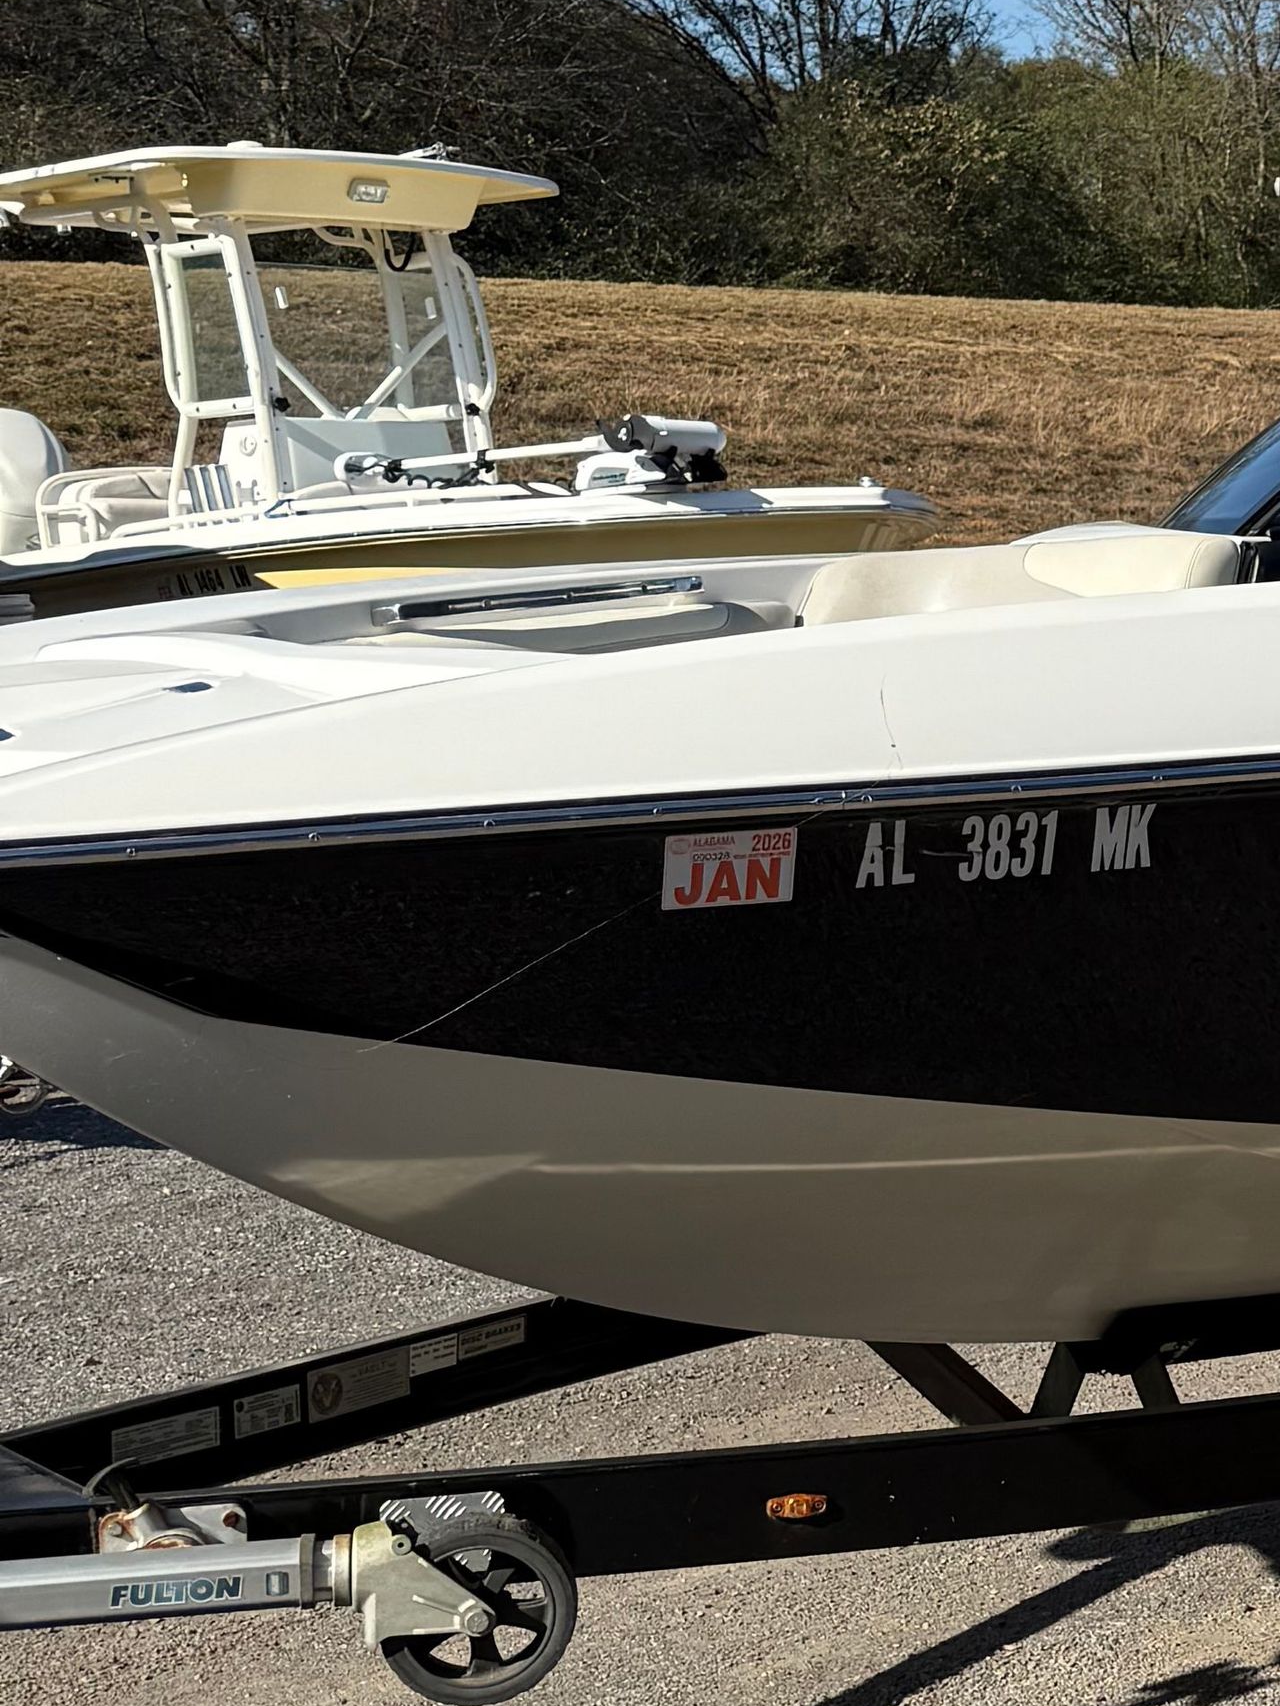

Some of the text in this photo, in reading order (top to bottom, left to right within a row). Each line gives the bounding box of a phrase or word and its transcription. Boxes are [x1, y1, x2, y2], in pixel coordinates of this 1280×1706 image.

[751, 832, 792, 852] 2026
[855, 803, 1157, 889] AL 3831 MK
[674, 857, 782, 906] JAN
[110, 1575, 244, 1609] FULTON
